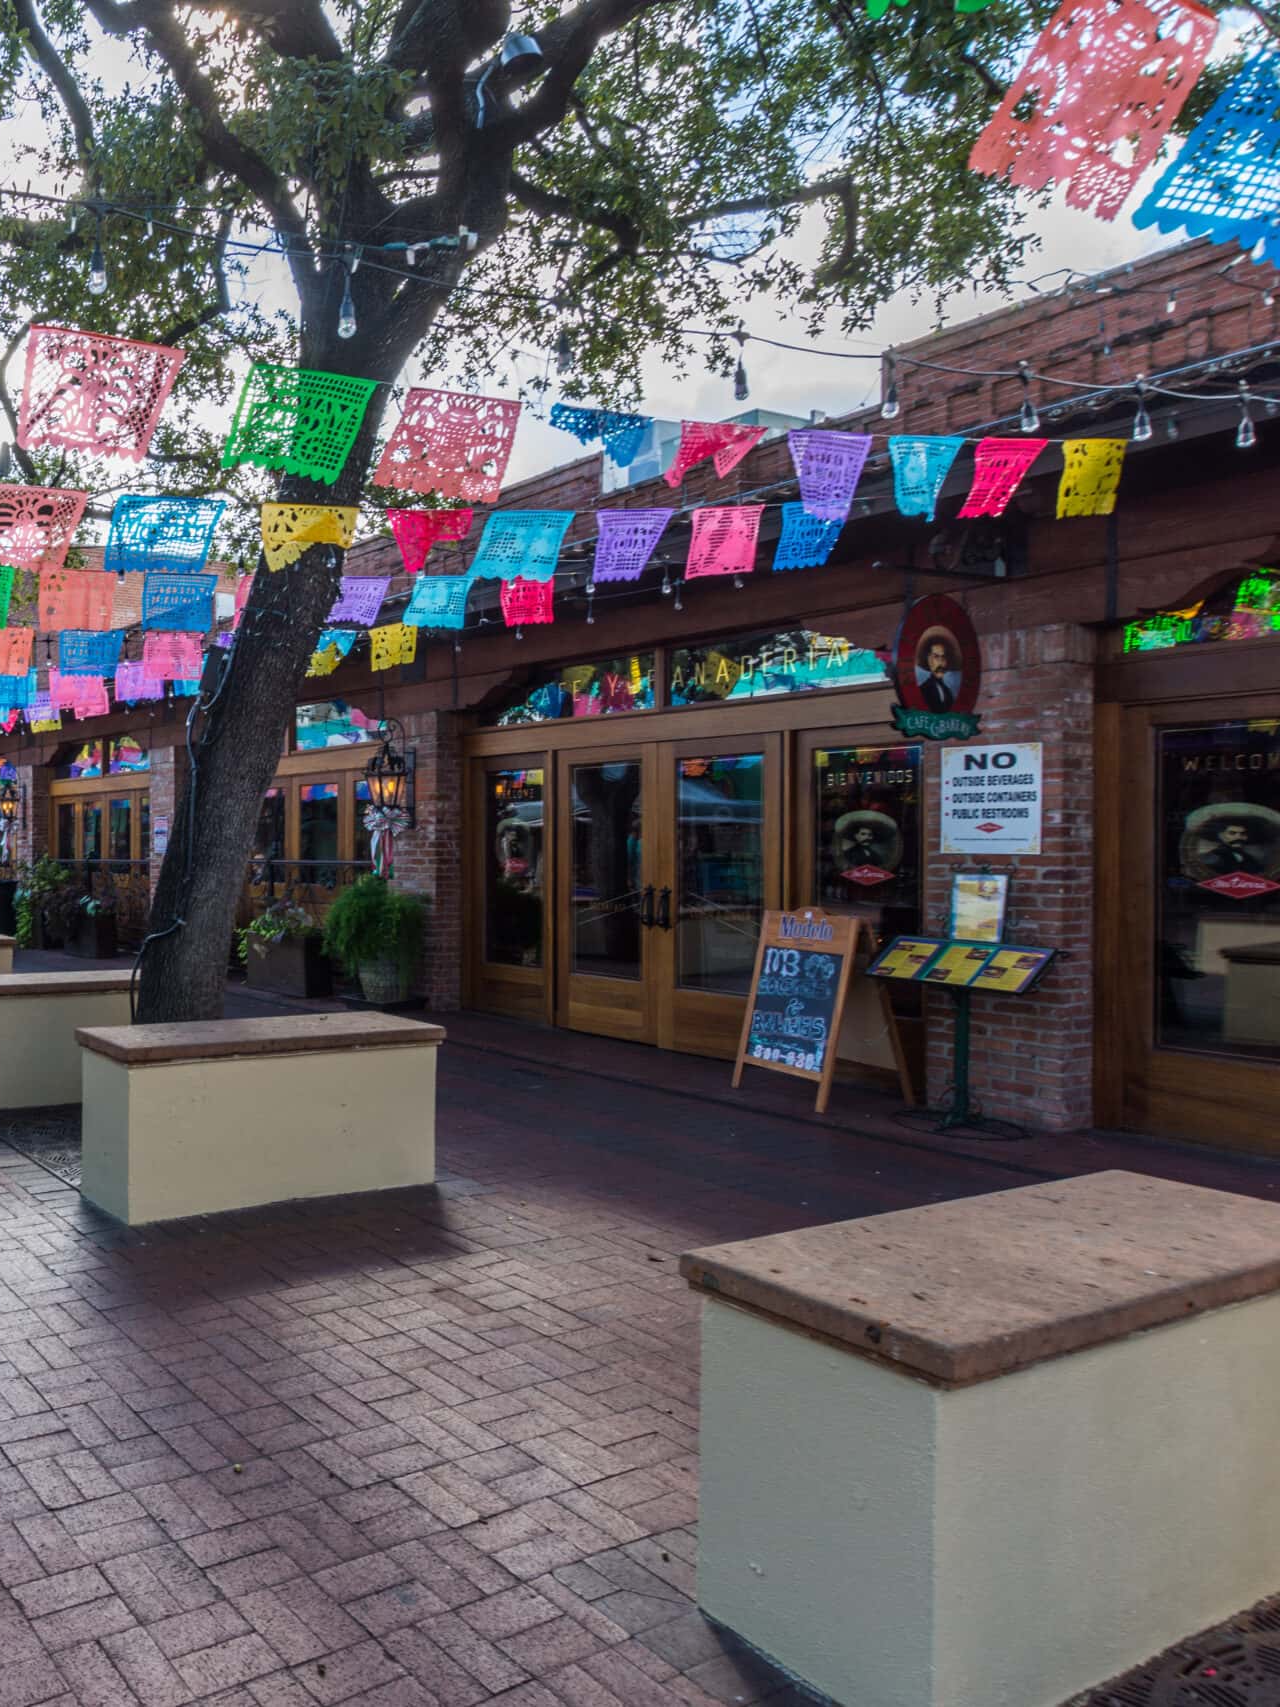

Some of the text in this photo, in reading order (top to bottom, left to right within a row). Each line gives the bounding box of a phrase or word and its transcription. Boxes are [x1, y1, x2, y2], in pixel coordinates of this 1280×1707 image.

[607, 671, 620, 697] Y
[963, 752, 1017, 771] NO
[952, 774, 1034, 788] OUTSIDE BEVERAGES
[952, 791, 1037, 804] OUTSIDE CONTAINERS
[952, 807, 1029, 820] PUBLIC RESTROOMS
[778, 914, 833, 942] Modelo
